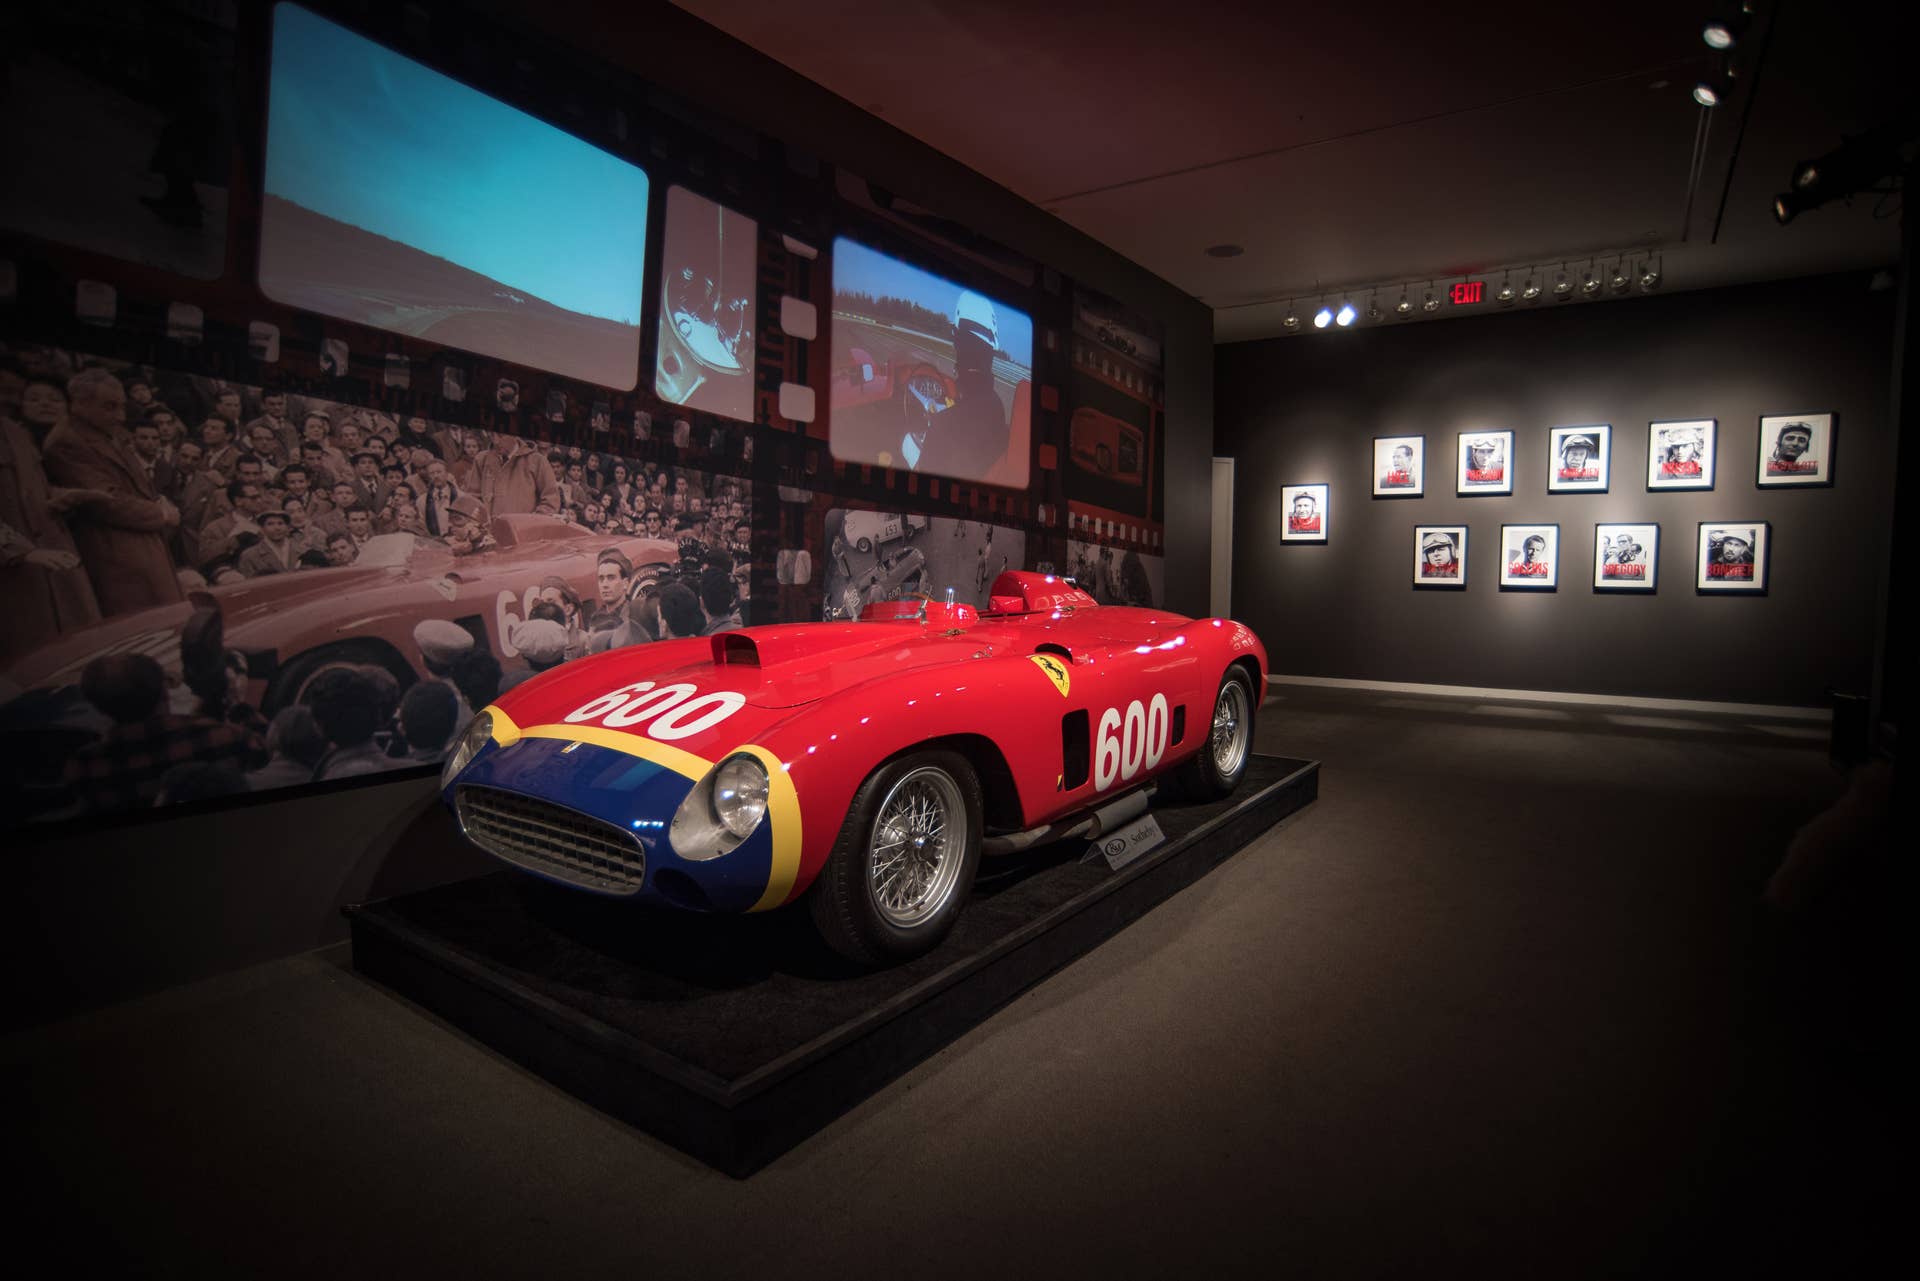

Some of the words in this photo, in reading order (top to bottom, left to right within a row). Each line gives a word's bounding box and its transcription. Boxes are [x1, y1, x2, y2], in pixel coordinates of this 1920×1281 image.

[1454, 281, 1483, 305] EXIT
[1508, 560, 1549, 575] COLLINS
[1601, 562, 1647, 577] GREGORY
[564, 681, 747, 740] 600
[1095, 692, 1169, 792] 600
